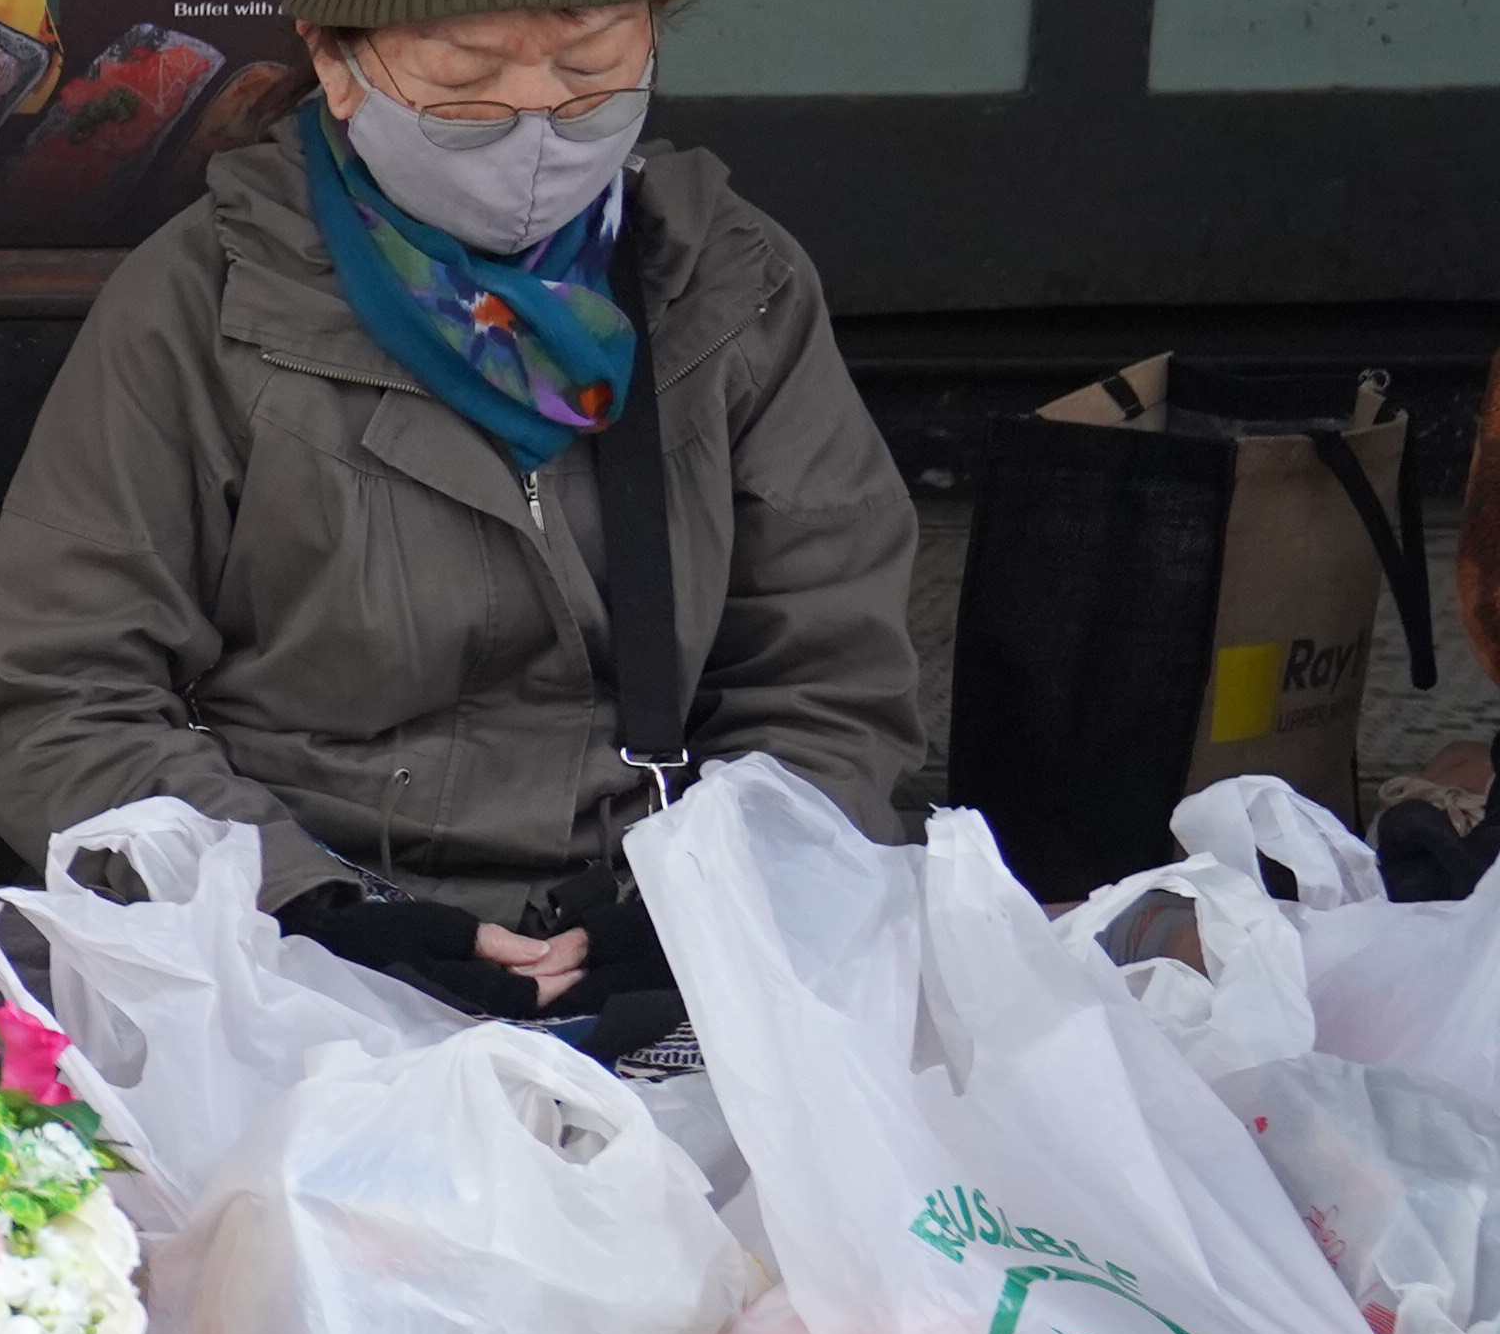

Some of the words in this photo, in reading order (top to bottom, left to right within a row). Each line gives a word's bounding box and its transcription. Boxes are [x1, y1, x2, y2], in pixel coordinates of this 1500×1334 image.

[174, 2, 230, 17] Buffet
[234, 1, 273, 16] with
[908, 1185, 1143, 1297] REUSABLE
